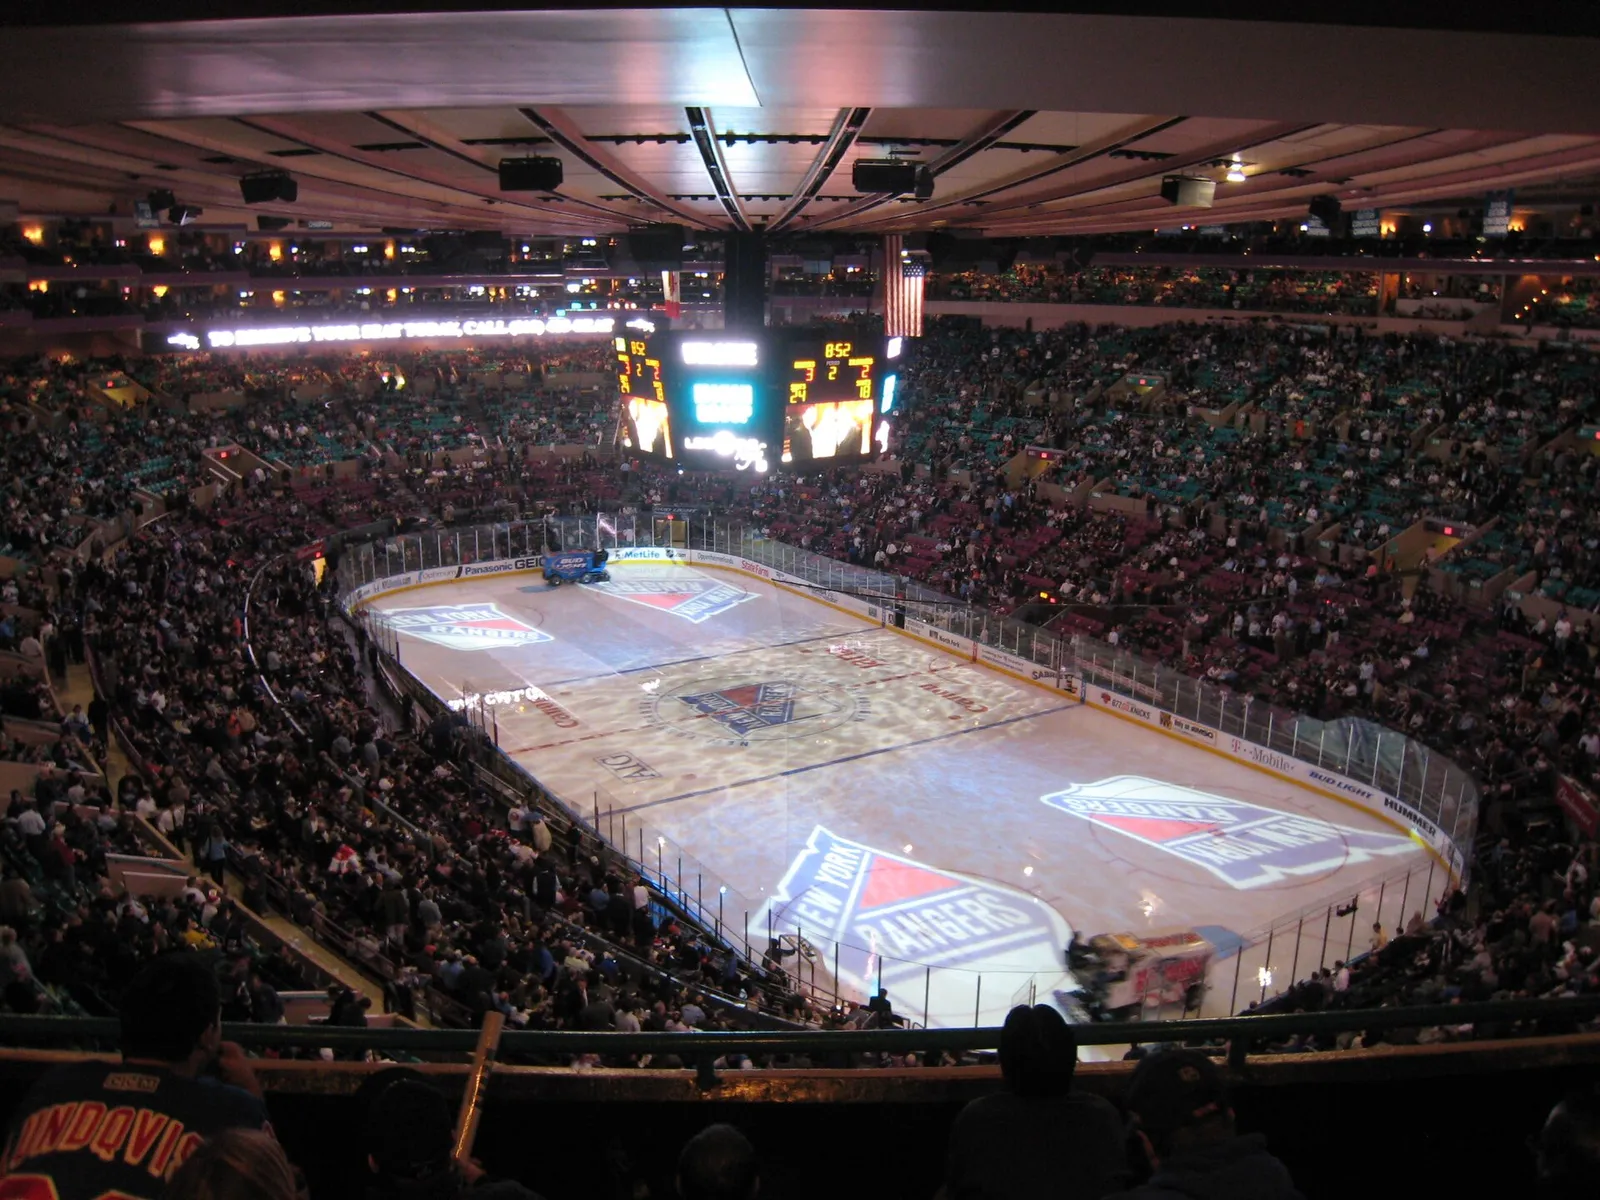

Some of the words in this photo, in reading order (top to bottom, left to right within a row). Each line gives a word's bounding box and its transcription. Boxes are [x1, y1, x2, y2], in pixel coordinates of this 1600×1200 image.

[463, 320, 509, 336] CALL
[825, 343, 851, 358] 8:52
[636, 363, 642, 377] 2
[806, 368, 814, 381] 3
[828, 366, 837, 380] 2
[861, 365, 870, 378] 2
[624, 550, 661, 559] MetLife
[465, 562, 513, 576] Panasonic
[515, 556, 543, 570] GEIC
[430, 625, 539, 640] RANGERS
[600, 753, 656, 779] AIG
[1309, 771, 1336, 785] BUD
[1384, 797, 1437, 838] HUMMER
[814, 842, 862, 889] YORK
[854, 892, 1034, 958] RANGERS
[0, 1100, 205, 1184] INDQVIS
